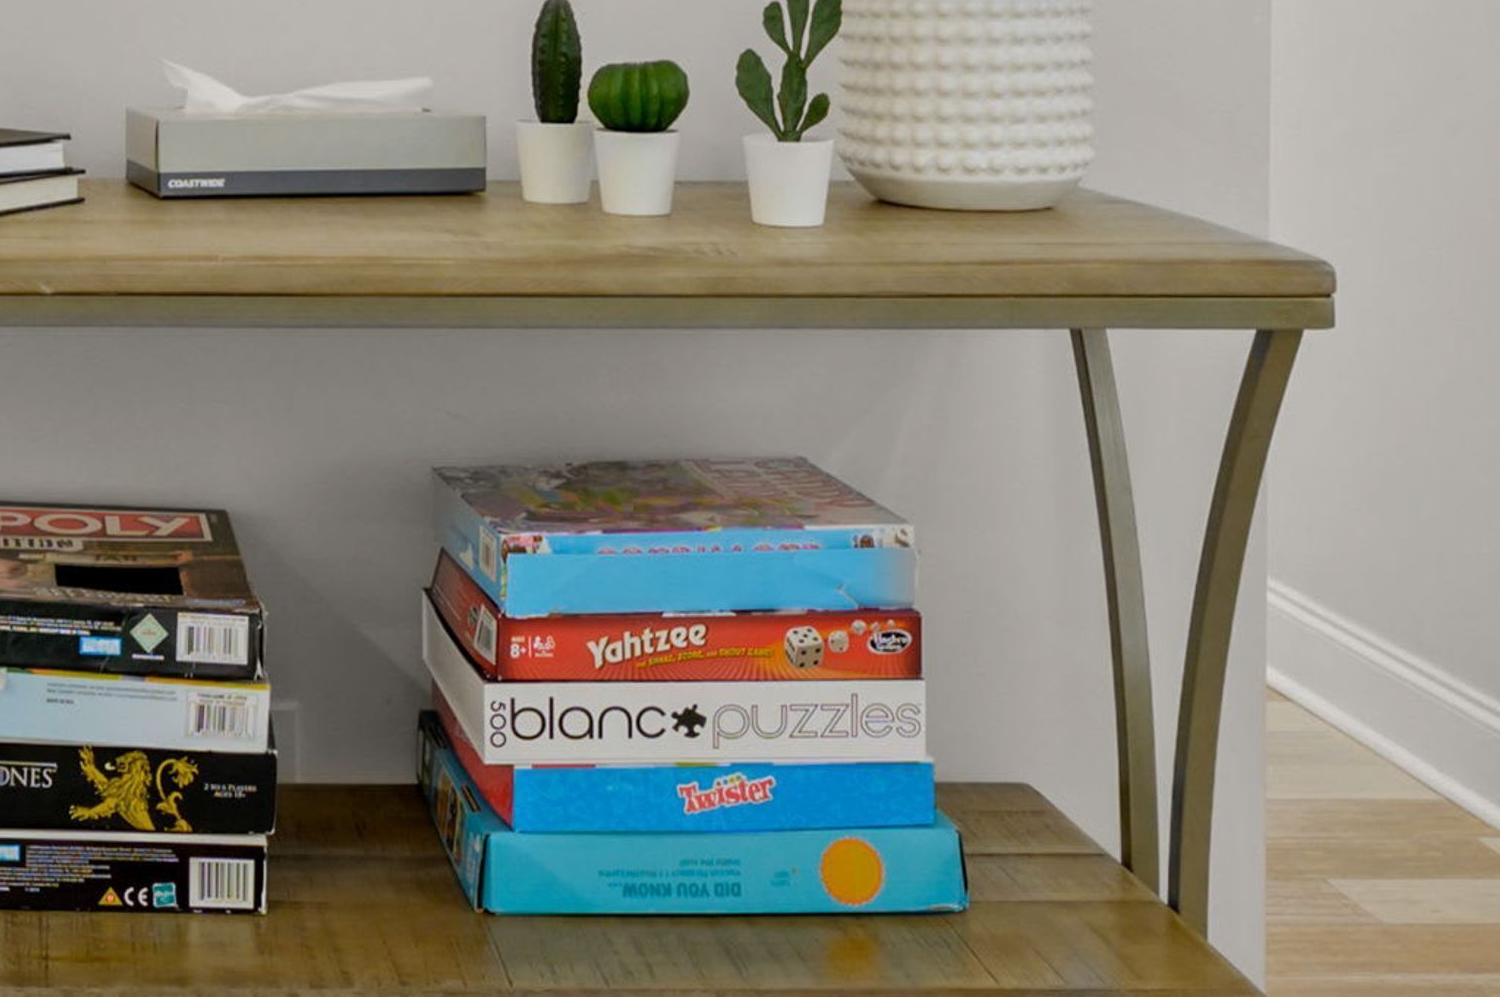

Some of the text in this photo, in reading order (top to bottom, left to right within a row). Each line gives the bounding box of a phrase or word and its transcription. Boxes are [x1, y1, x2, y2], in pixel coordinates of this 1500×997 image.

[510, 642, 527, 659] 8+
[586, 623, 708, 669] Yahtzee
[490, 700, 507, 749] 500
[510, 692, 922, 750] blanc puzzles
[678, 775, 775, 813] Twister
[677, 882, 710, 898] YOU
[714, 882, 742, 898] DID
